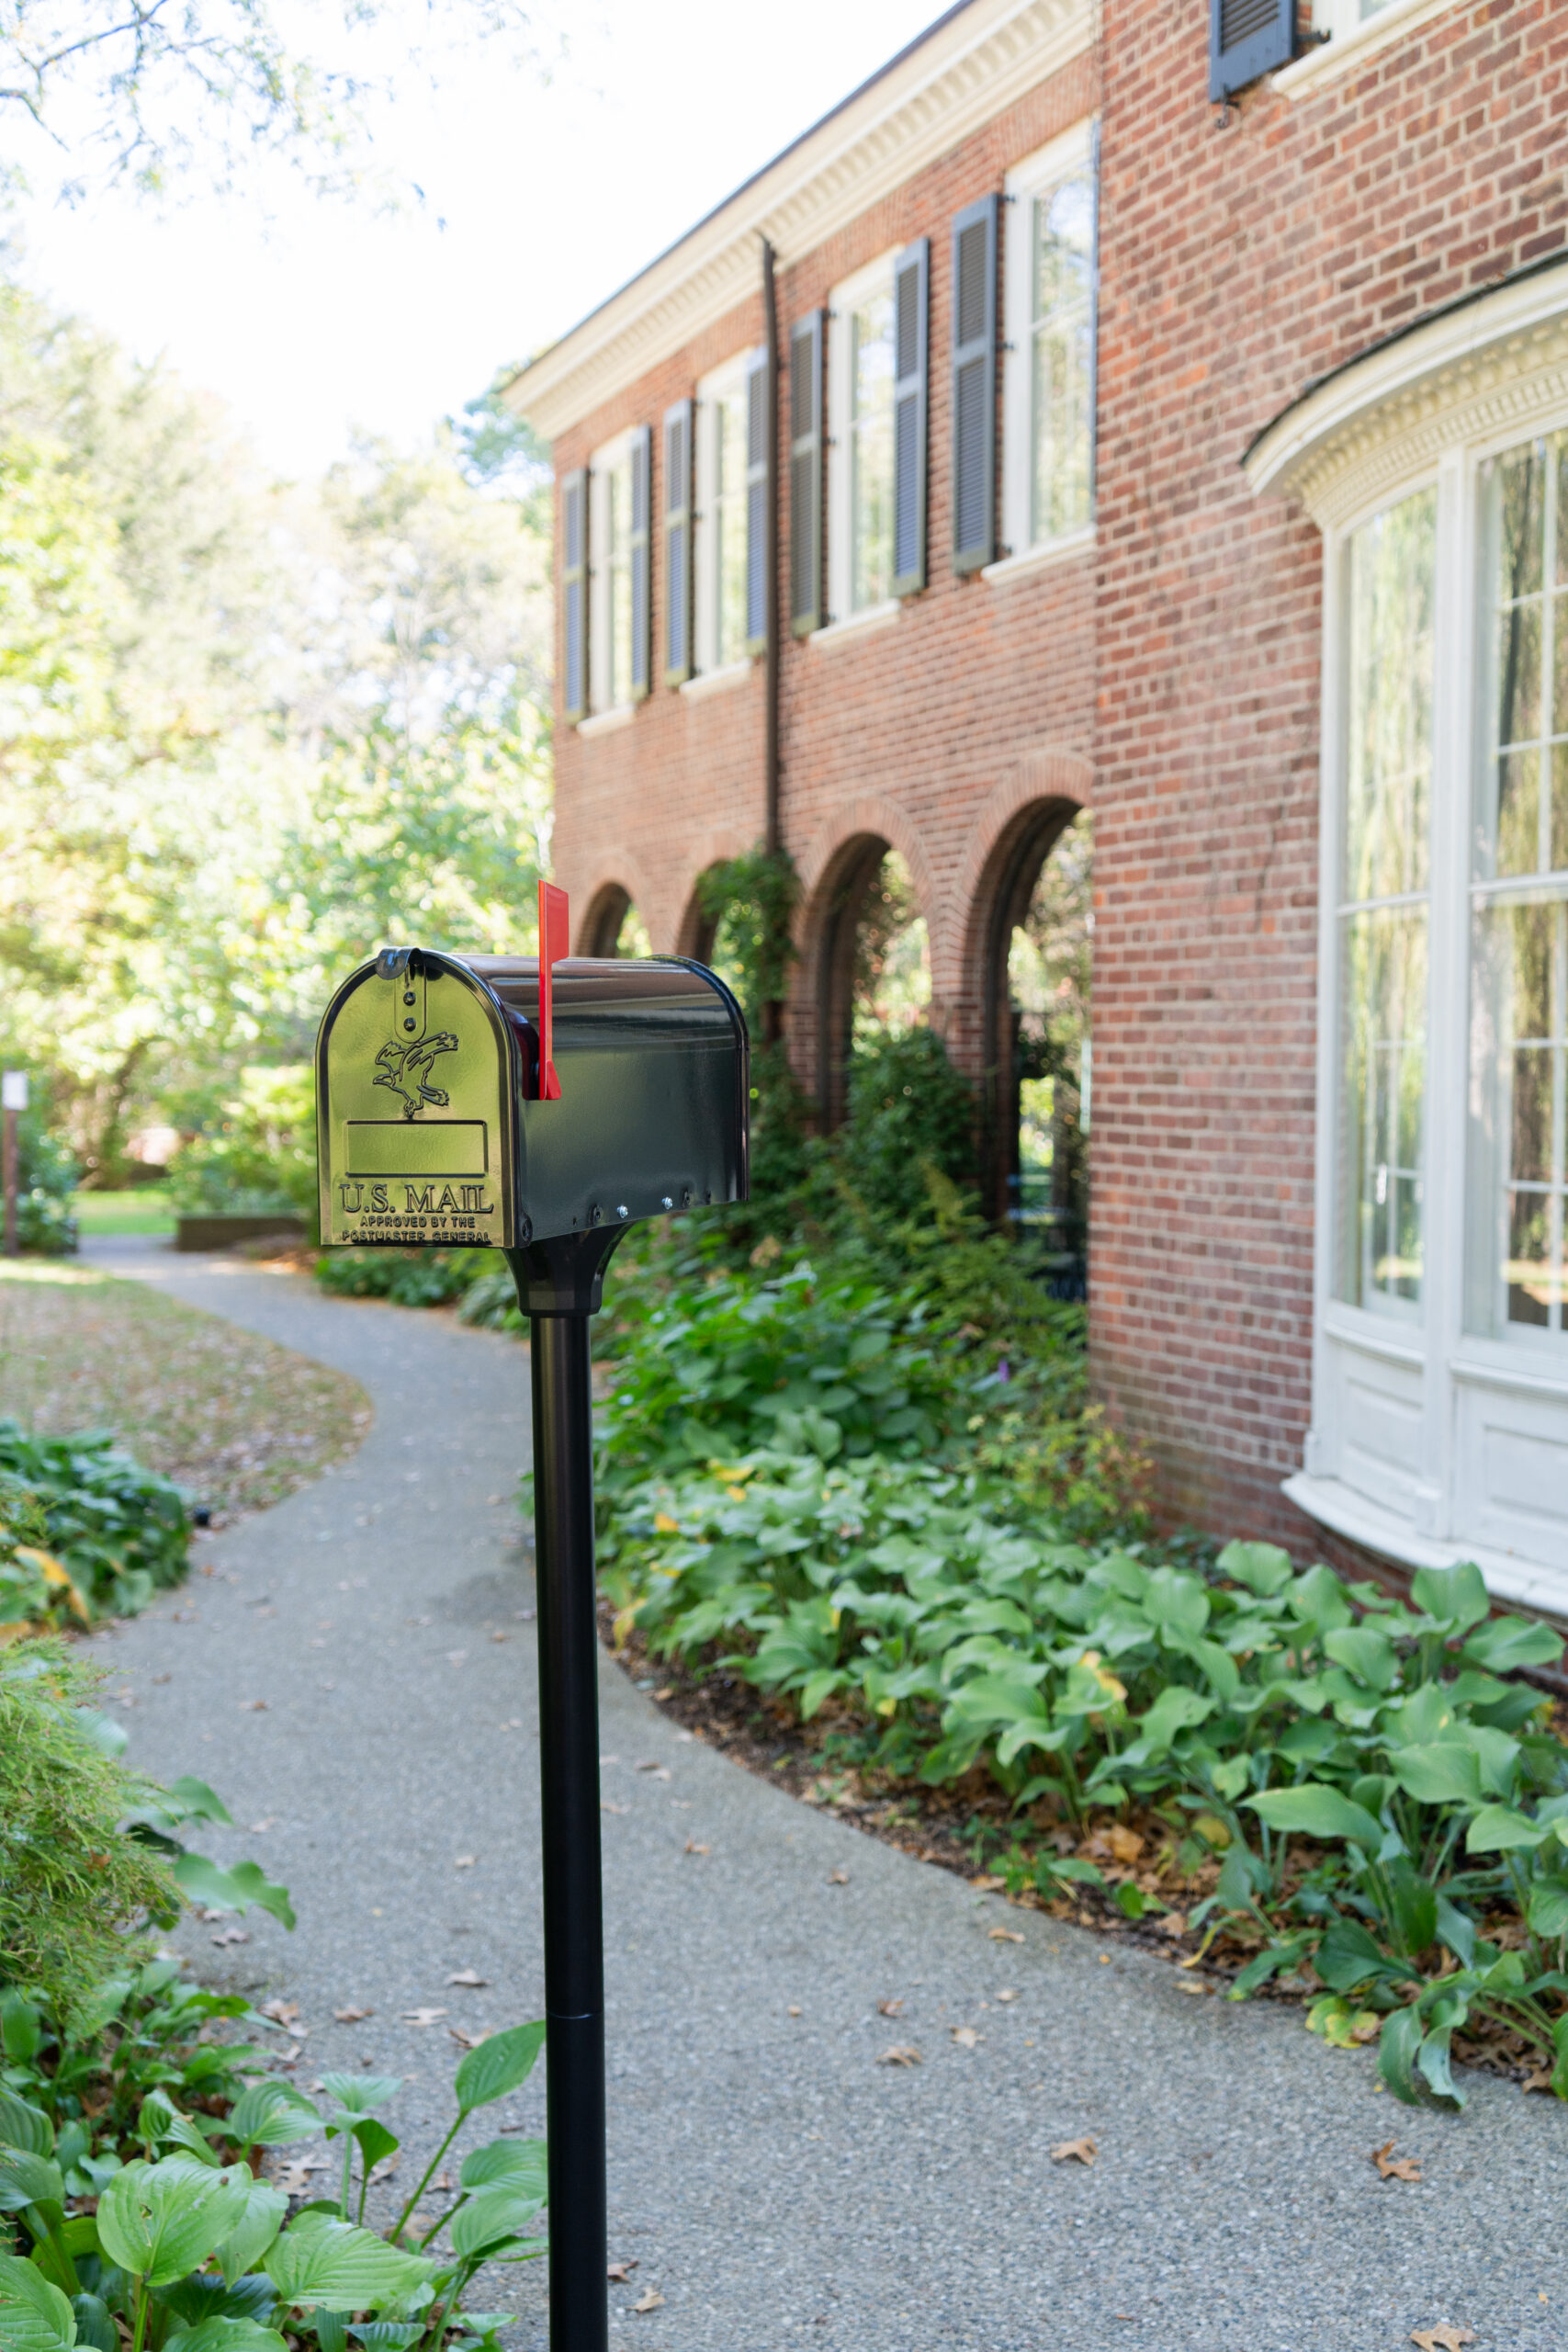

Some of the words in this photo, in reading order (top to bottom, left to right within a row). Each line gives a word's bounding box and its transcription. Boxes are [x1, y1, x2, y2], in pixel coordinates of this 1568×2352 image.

[339, 1183, 396, 1214] U.S.
[404, 1184, 494, 1214] MAIL
[359, 1216, 427, 1228] APPROVED
[431, 1216, 447, 1228] BY
[451, 1216, 476, 1228] THE
[342, 1229, 426, 1243] POSTMASTER
[432, 1230, 491, 1244] GENERAL
